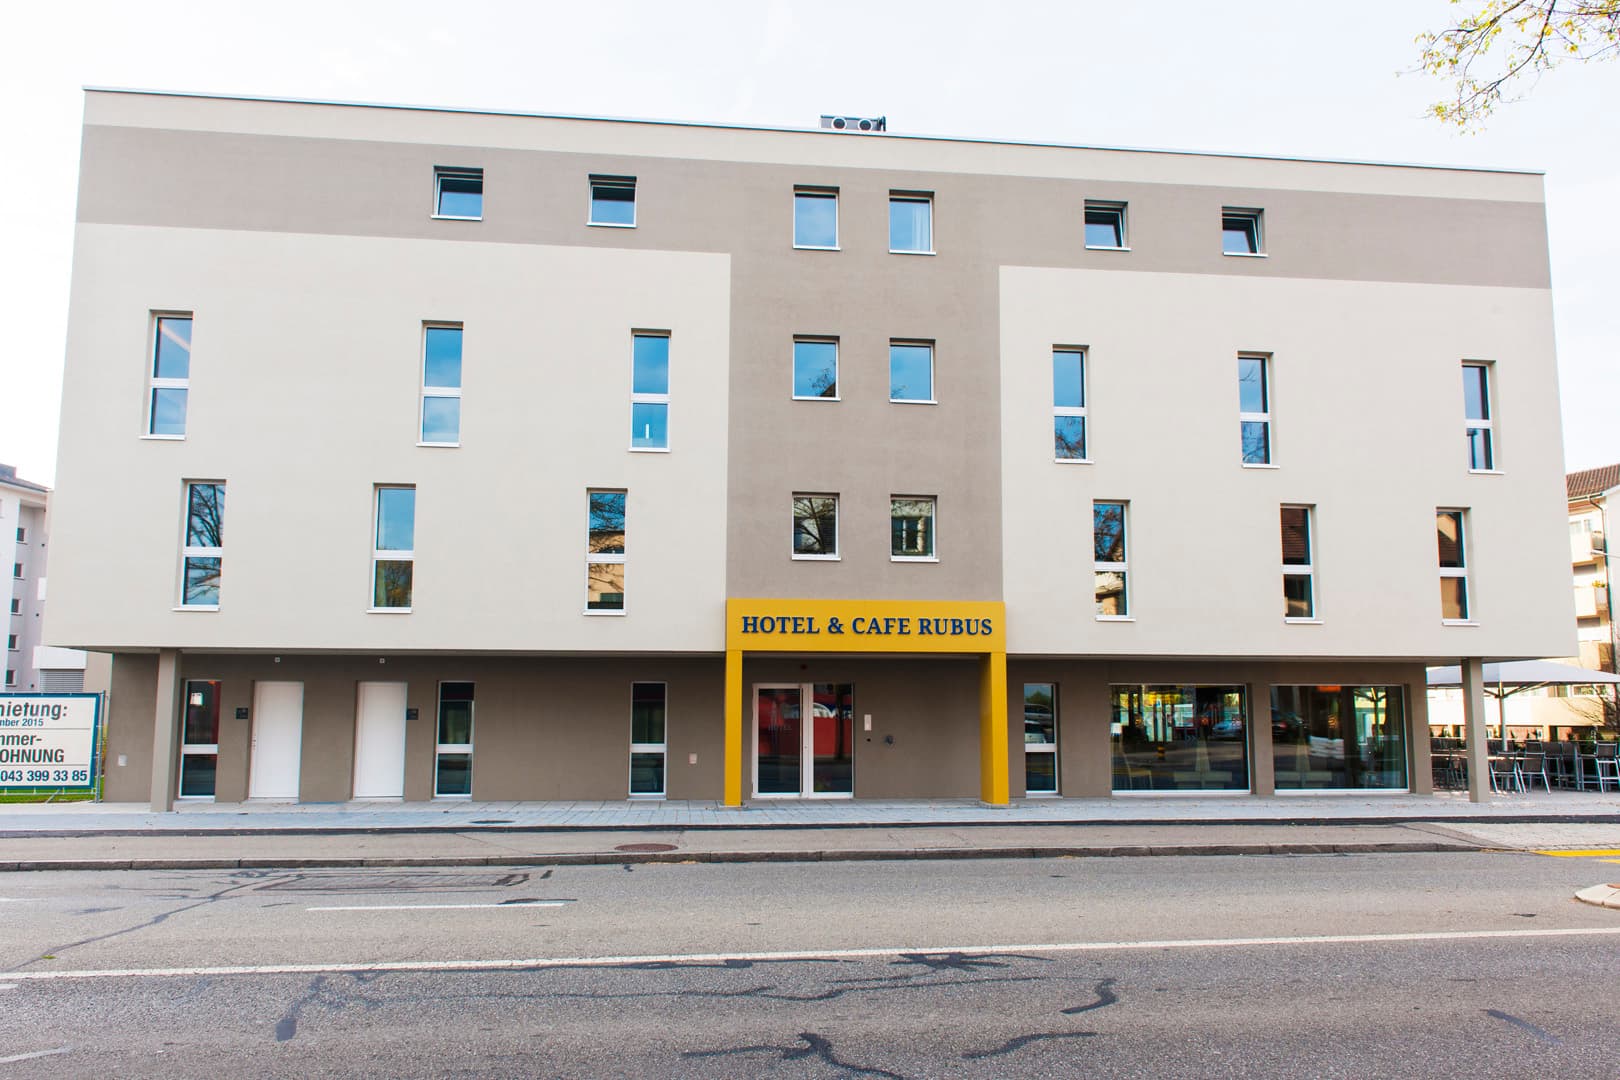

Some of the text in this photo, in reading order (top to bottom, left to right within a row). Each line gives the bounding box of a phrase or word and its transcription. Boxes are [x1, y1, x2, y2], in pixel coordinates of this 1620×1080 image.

[742, 616, 993, 636] HOTEL & CAFE RUBUS
[22, 718, 44, 727] 2015
[1, 770, 88, 782] 043 399 33 85
